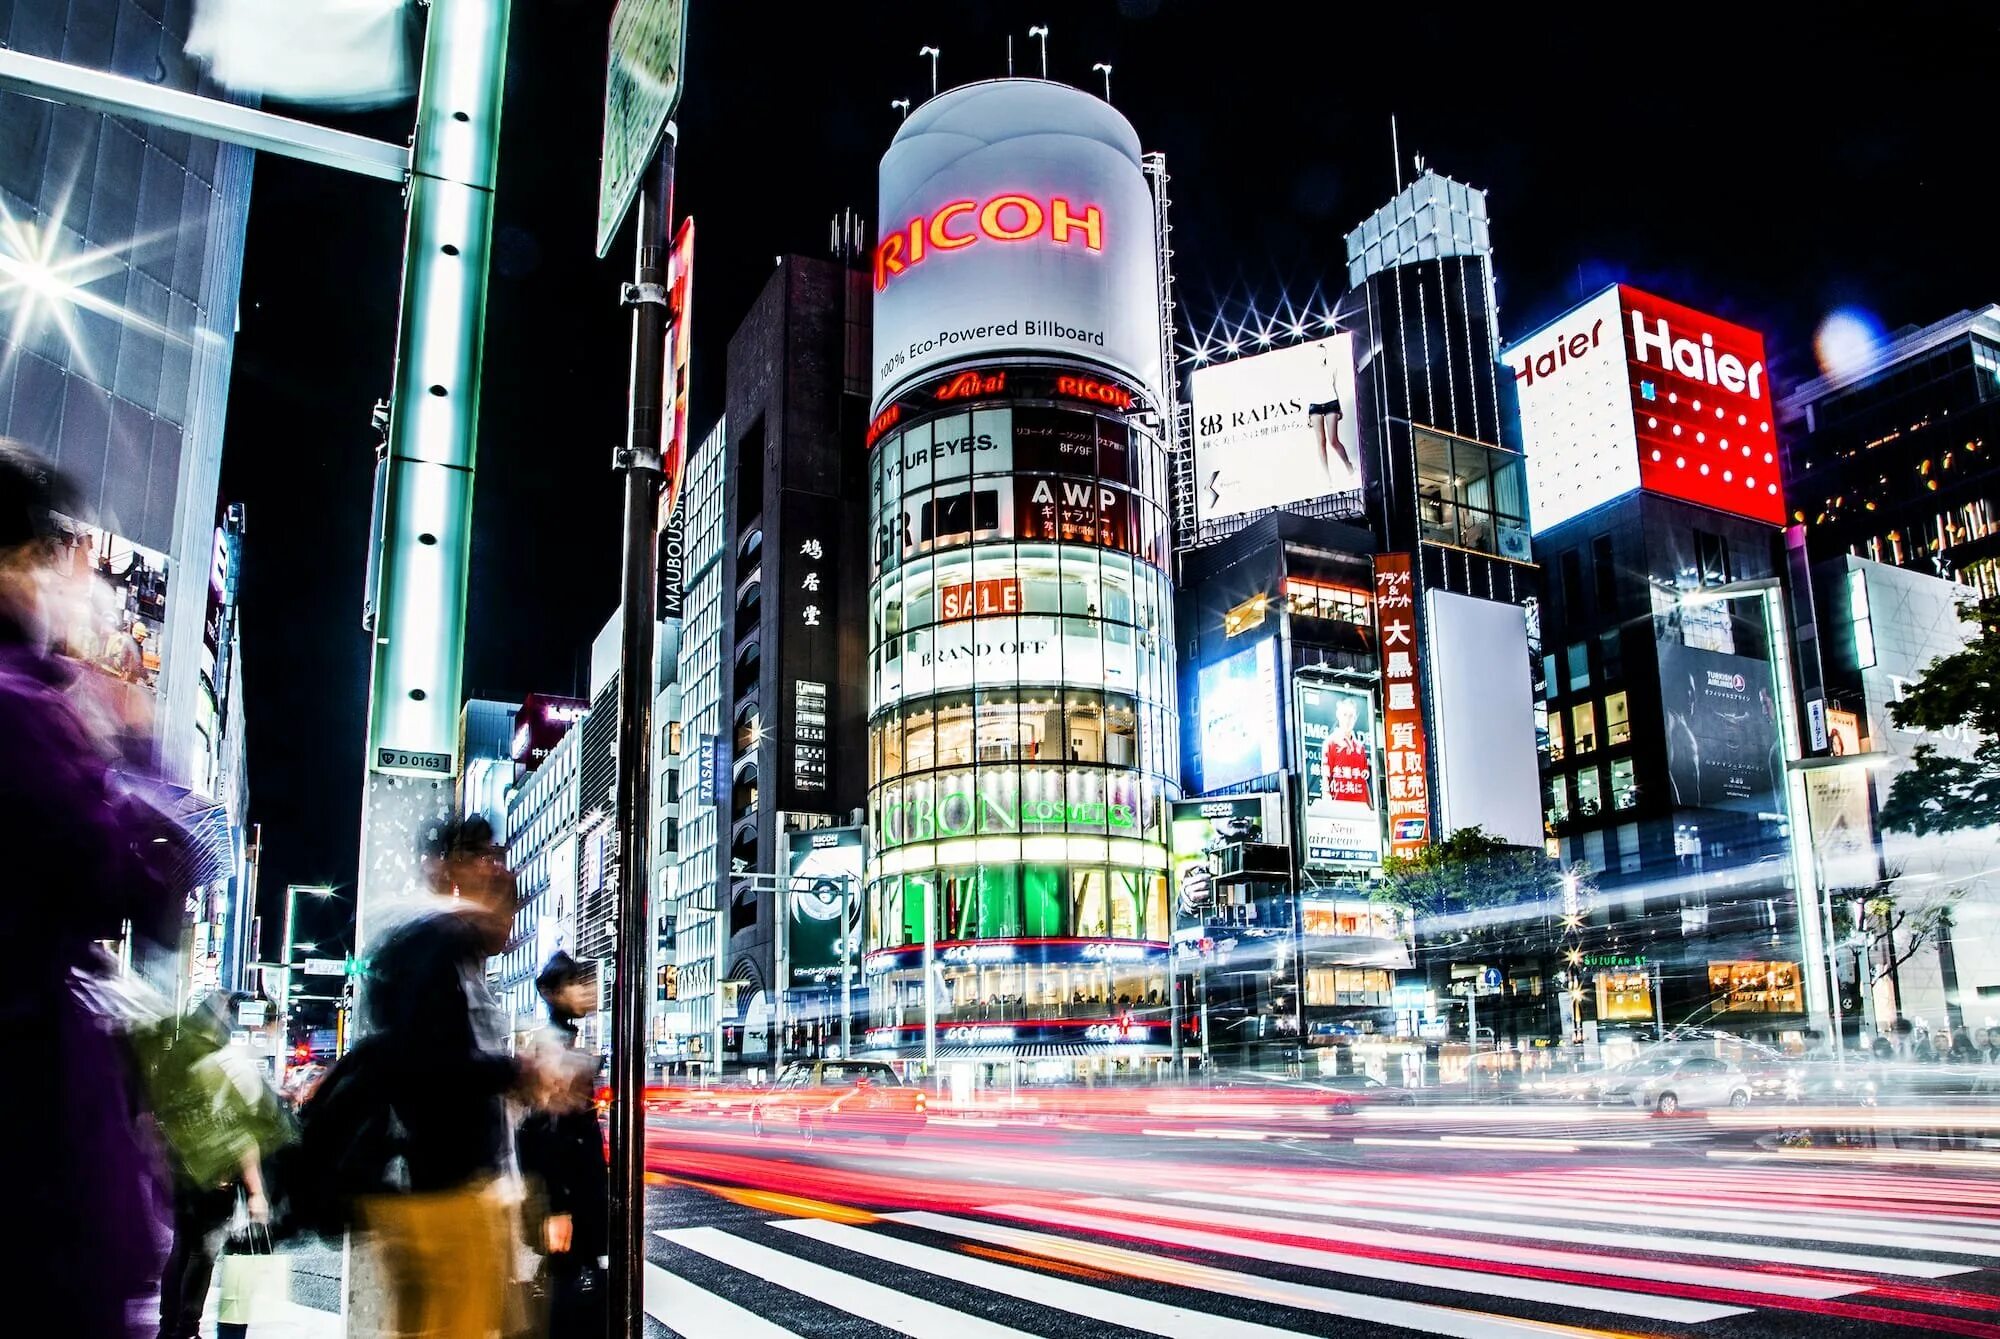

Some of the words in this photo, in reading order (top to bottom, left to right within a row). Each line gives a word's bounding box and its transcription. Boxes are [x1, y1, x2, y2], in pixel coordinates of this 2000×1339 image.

[874, 195, 1102, 292] RICOH
[880, 350, 905, 381] 100%
[909, 321, 1018, 358] Eco-Powered
[1025, 321, 1104, 347] Billboard
[1515, 318, 1603, 387] Haier
[1631, 309, 1764, 400] Haier
[1057, 375, 1131, 409] RICOH
[1232, 398, 1302, 428] RAPAS
[932, 434, 998, 461] EYES.
[1060, 442, 1093, 457] 8F/9F
[875, 511, 912, 566] GR
[800, 539, 823, 626] 鳩居堂
[1376, 571, 1410, 586] ブランド
[1388, 585, 1399, 595] &
[944, 585, 1018, 619] SALE
[1378, 595, 1412, 609] チケット
[921, 644, 991, 667] BRAND
[1000, 640, 1048, 655] OFF
[1383, 619, 1415, 711] 大黒屋
[1391, 723, 1417, 750] 質
[399, 755, 408, 765] D
[411, 756, 440, 769] 0163
[701, 740, 713, 800] TASAKI
[1390, 774, 1425, 800] 販売
[1201, 803, 1232, 813] RICOH
[813, 834, 838, 843] RICOH
[1584, 955, 1630, 966] SUZURAN
